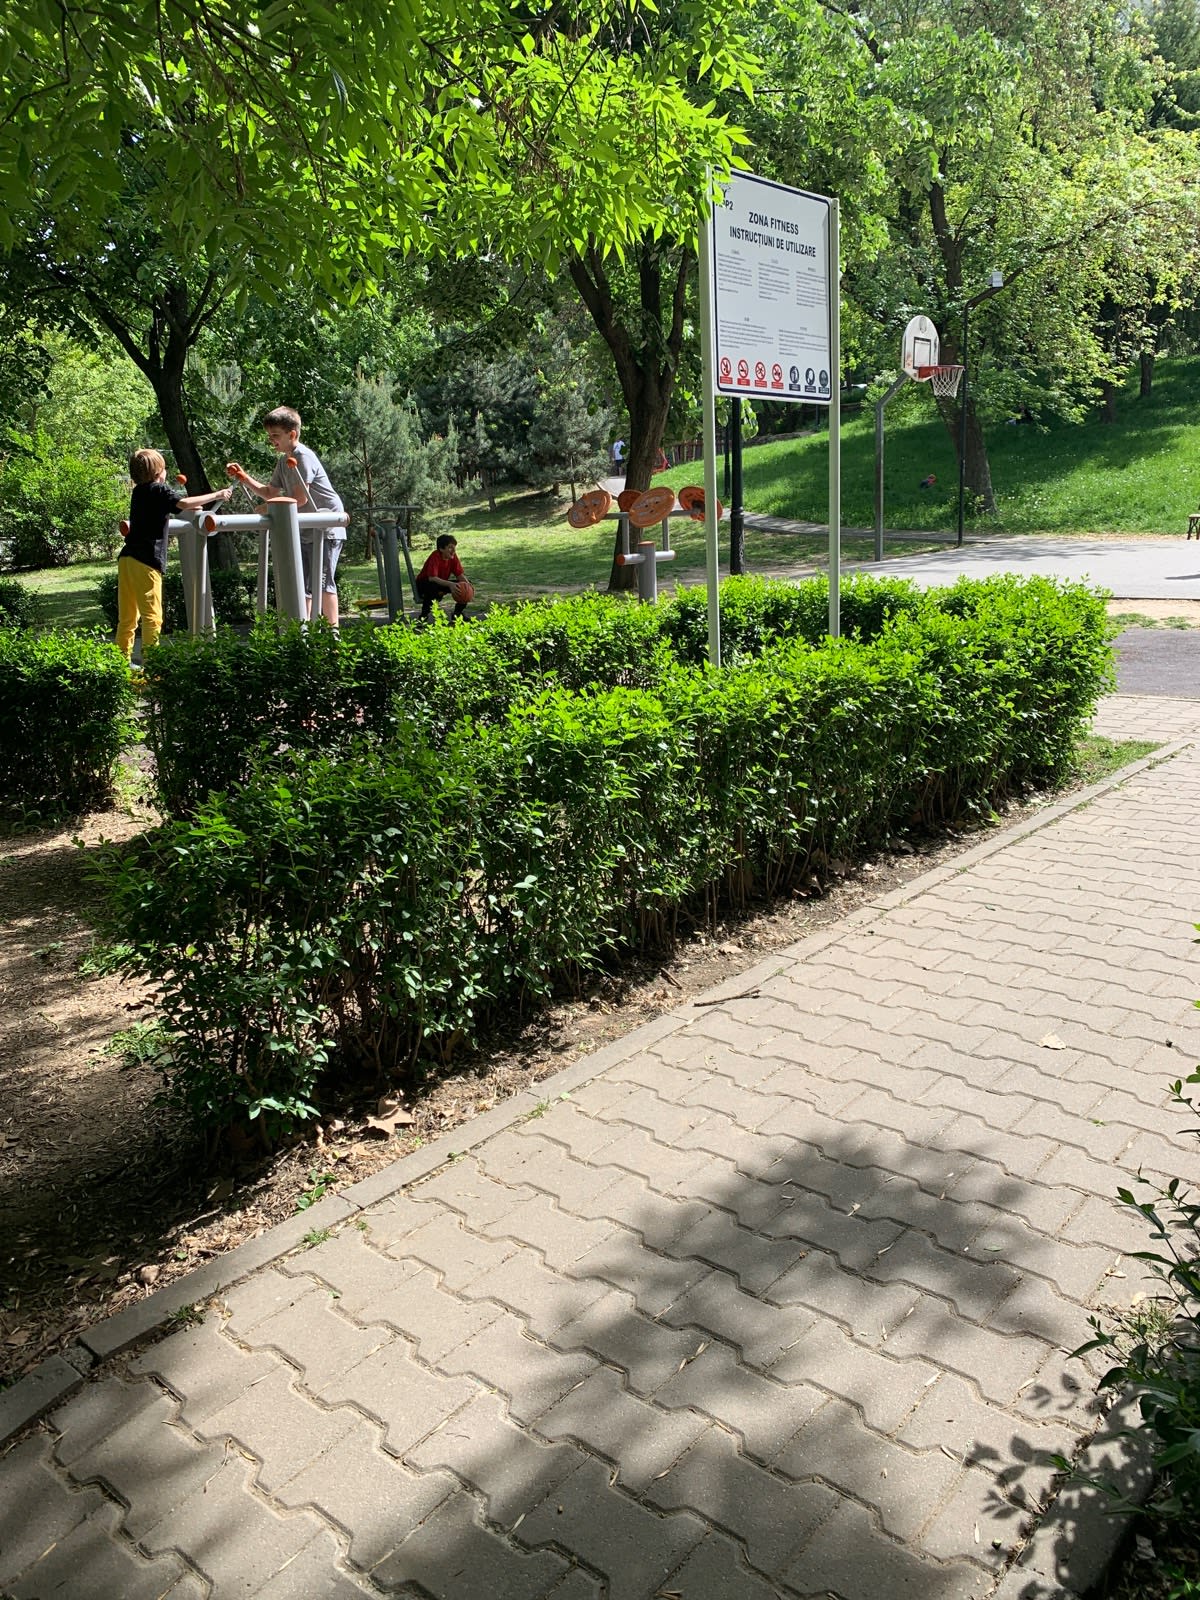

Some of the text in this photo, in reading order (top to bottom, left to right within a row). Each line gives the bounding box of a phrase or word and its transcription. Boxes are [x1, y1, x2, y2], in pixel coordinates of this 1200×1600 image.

[749, 211, 799, 235] ZONA FITNESS
[776, 237, 784, 250] DE
[785, 240, 817, 258] UTILIZARE
